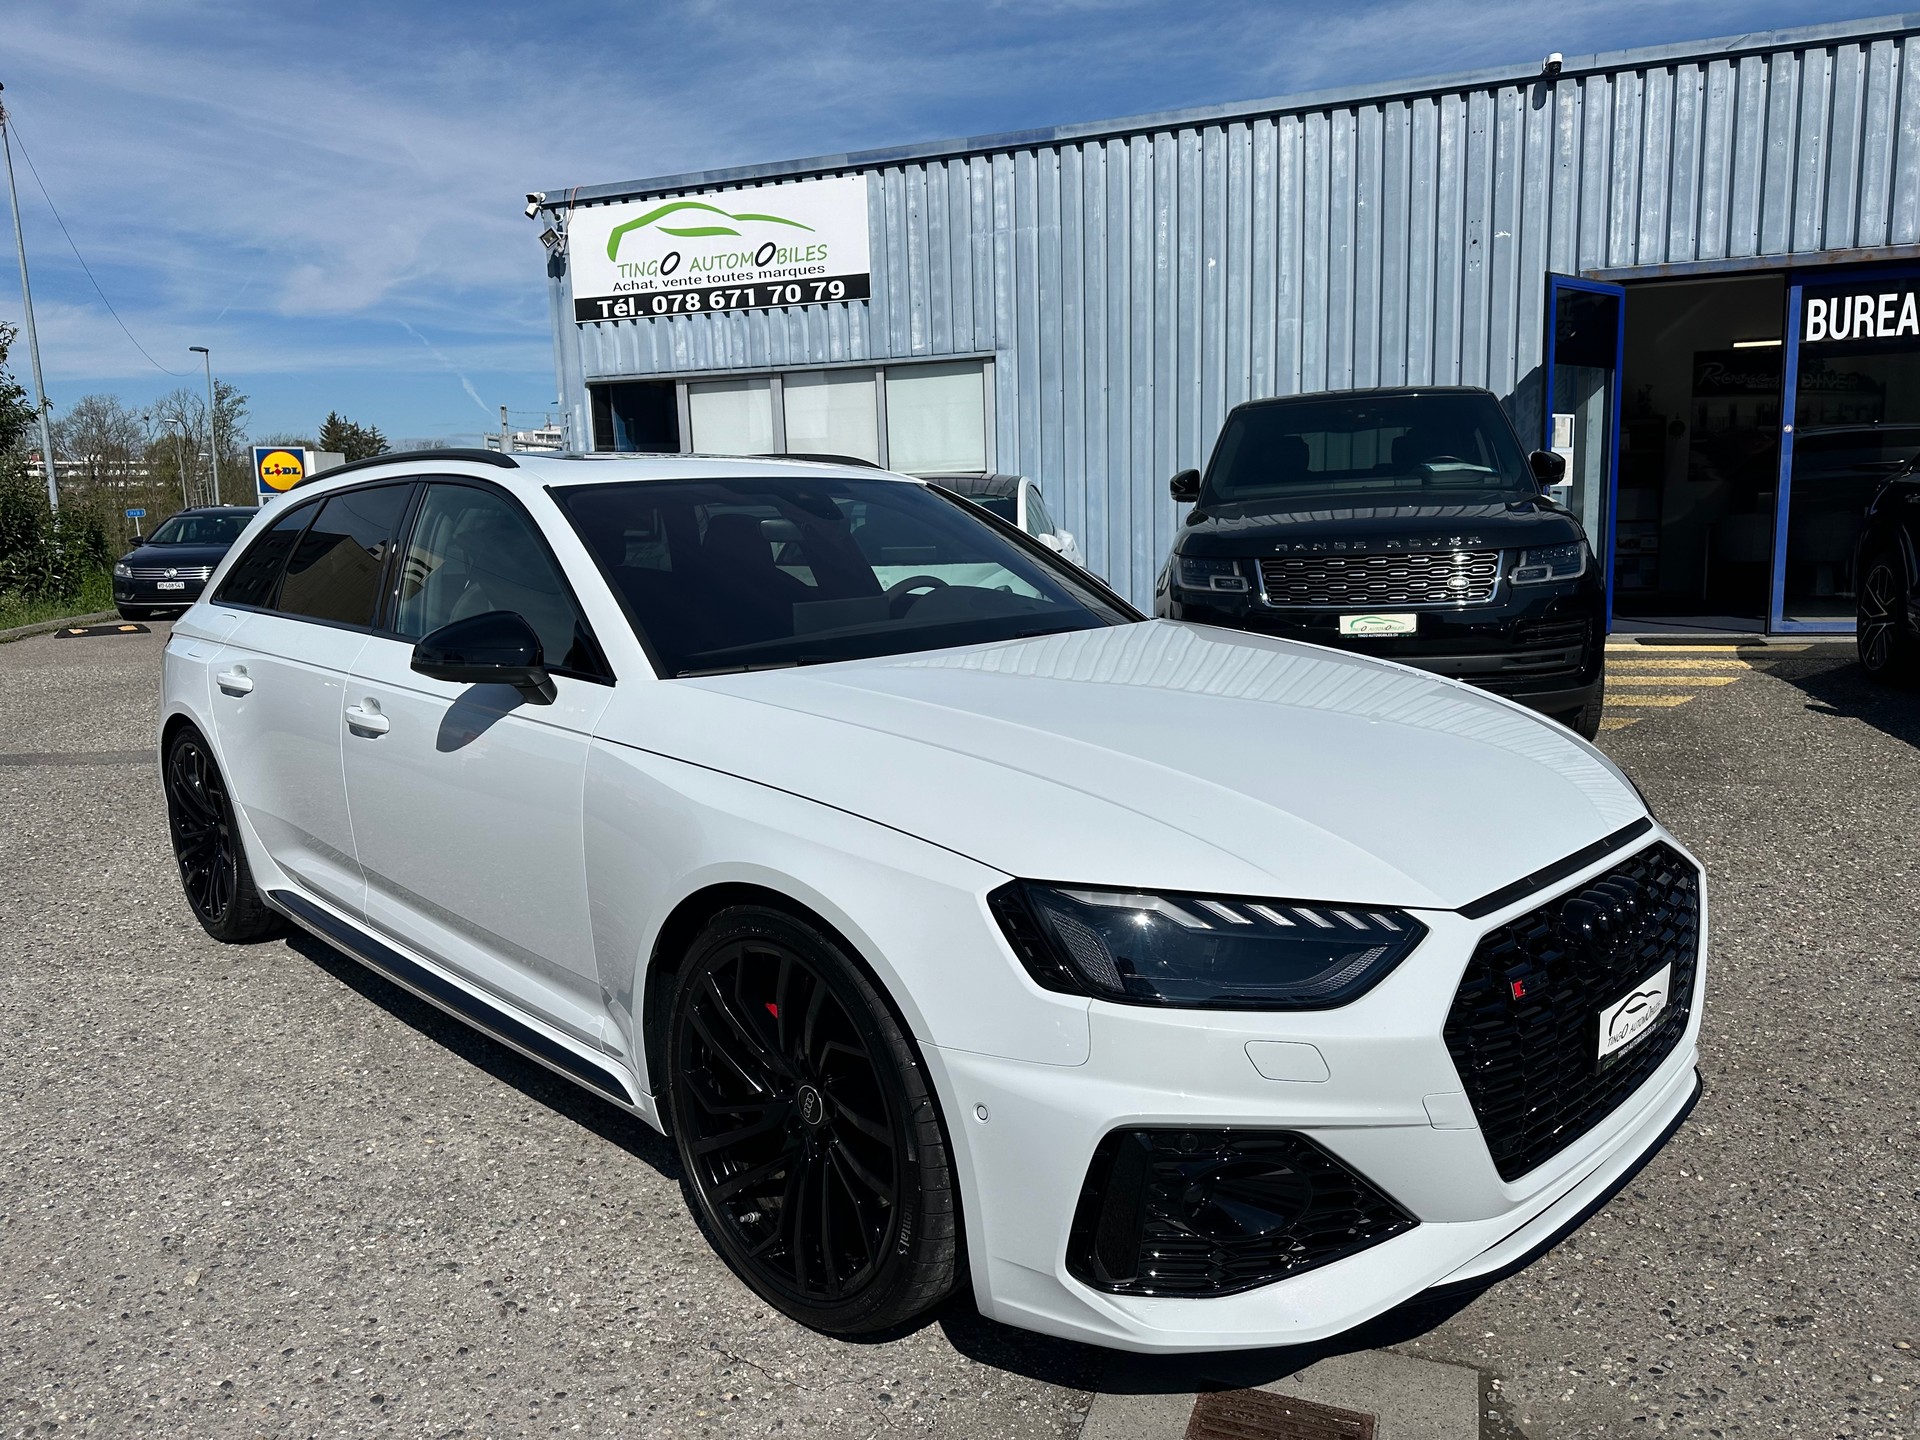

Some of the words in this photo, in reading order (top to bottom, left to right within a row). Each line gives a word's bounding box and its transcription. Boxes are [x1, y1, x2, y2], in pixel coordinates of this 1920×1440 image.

[617, 251, 681, 279] TINGO
[689, 241, 829, 273] AUTOMOBILES
[612, 276, 659, 292] Achat,
[662, 274, 703, 287] vente
[706, 269, 754, 284] toutes
[758, 264, 826, 280] marques
[597, 298, 644, 318] Tél.
[652, 292, 701, 314] 078
[708, 287, 757, 310] 671
[766, 283, 802, 305] 70
[809, 280, 846, 302] 79
[1275, 541, 1367, 552] RANGE
[1386, 536, 1482, 548] ROVER
[1607, 1023, 1629, 1047] TINGO
